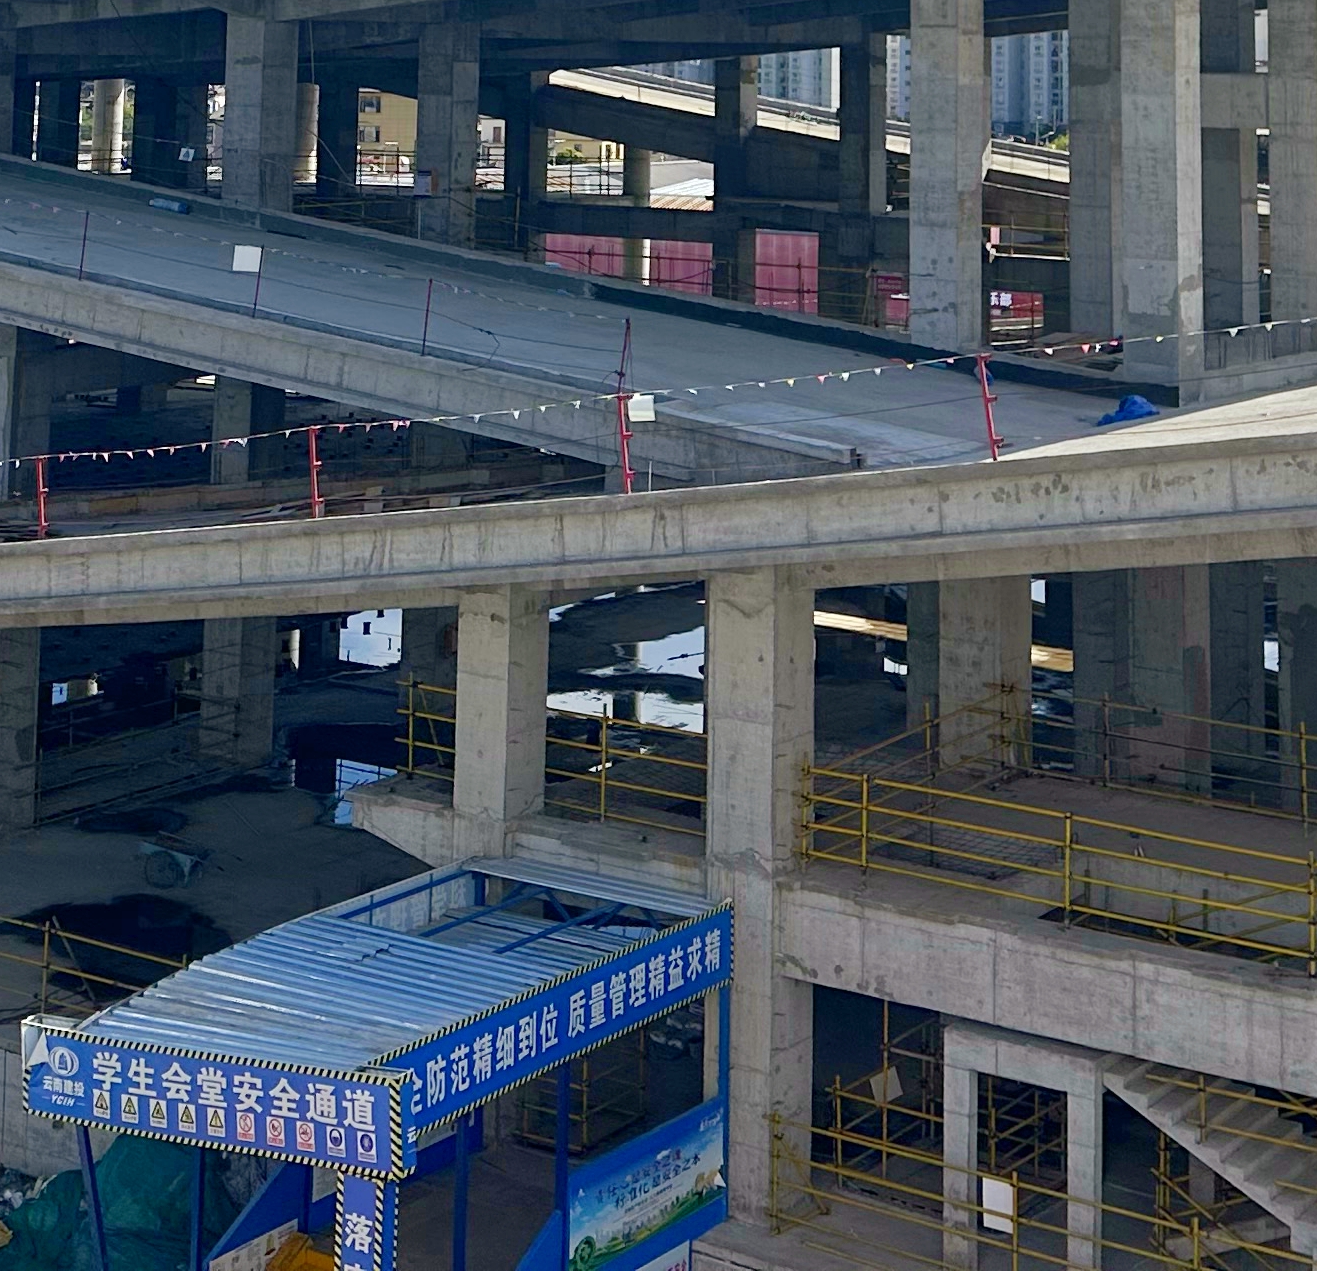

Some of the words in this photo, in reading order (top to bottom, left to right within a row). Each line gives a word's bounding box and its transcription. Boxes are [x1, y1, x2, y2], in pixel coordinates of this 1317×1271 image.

[567, 928, 721, 1038] 质量管理精益求精
[42, 1075, 85, 1098] 云南建投
[92, 1051, 376, 1131] 学生会堂安全通道
